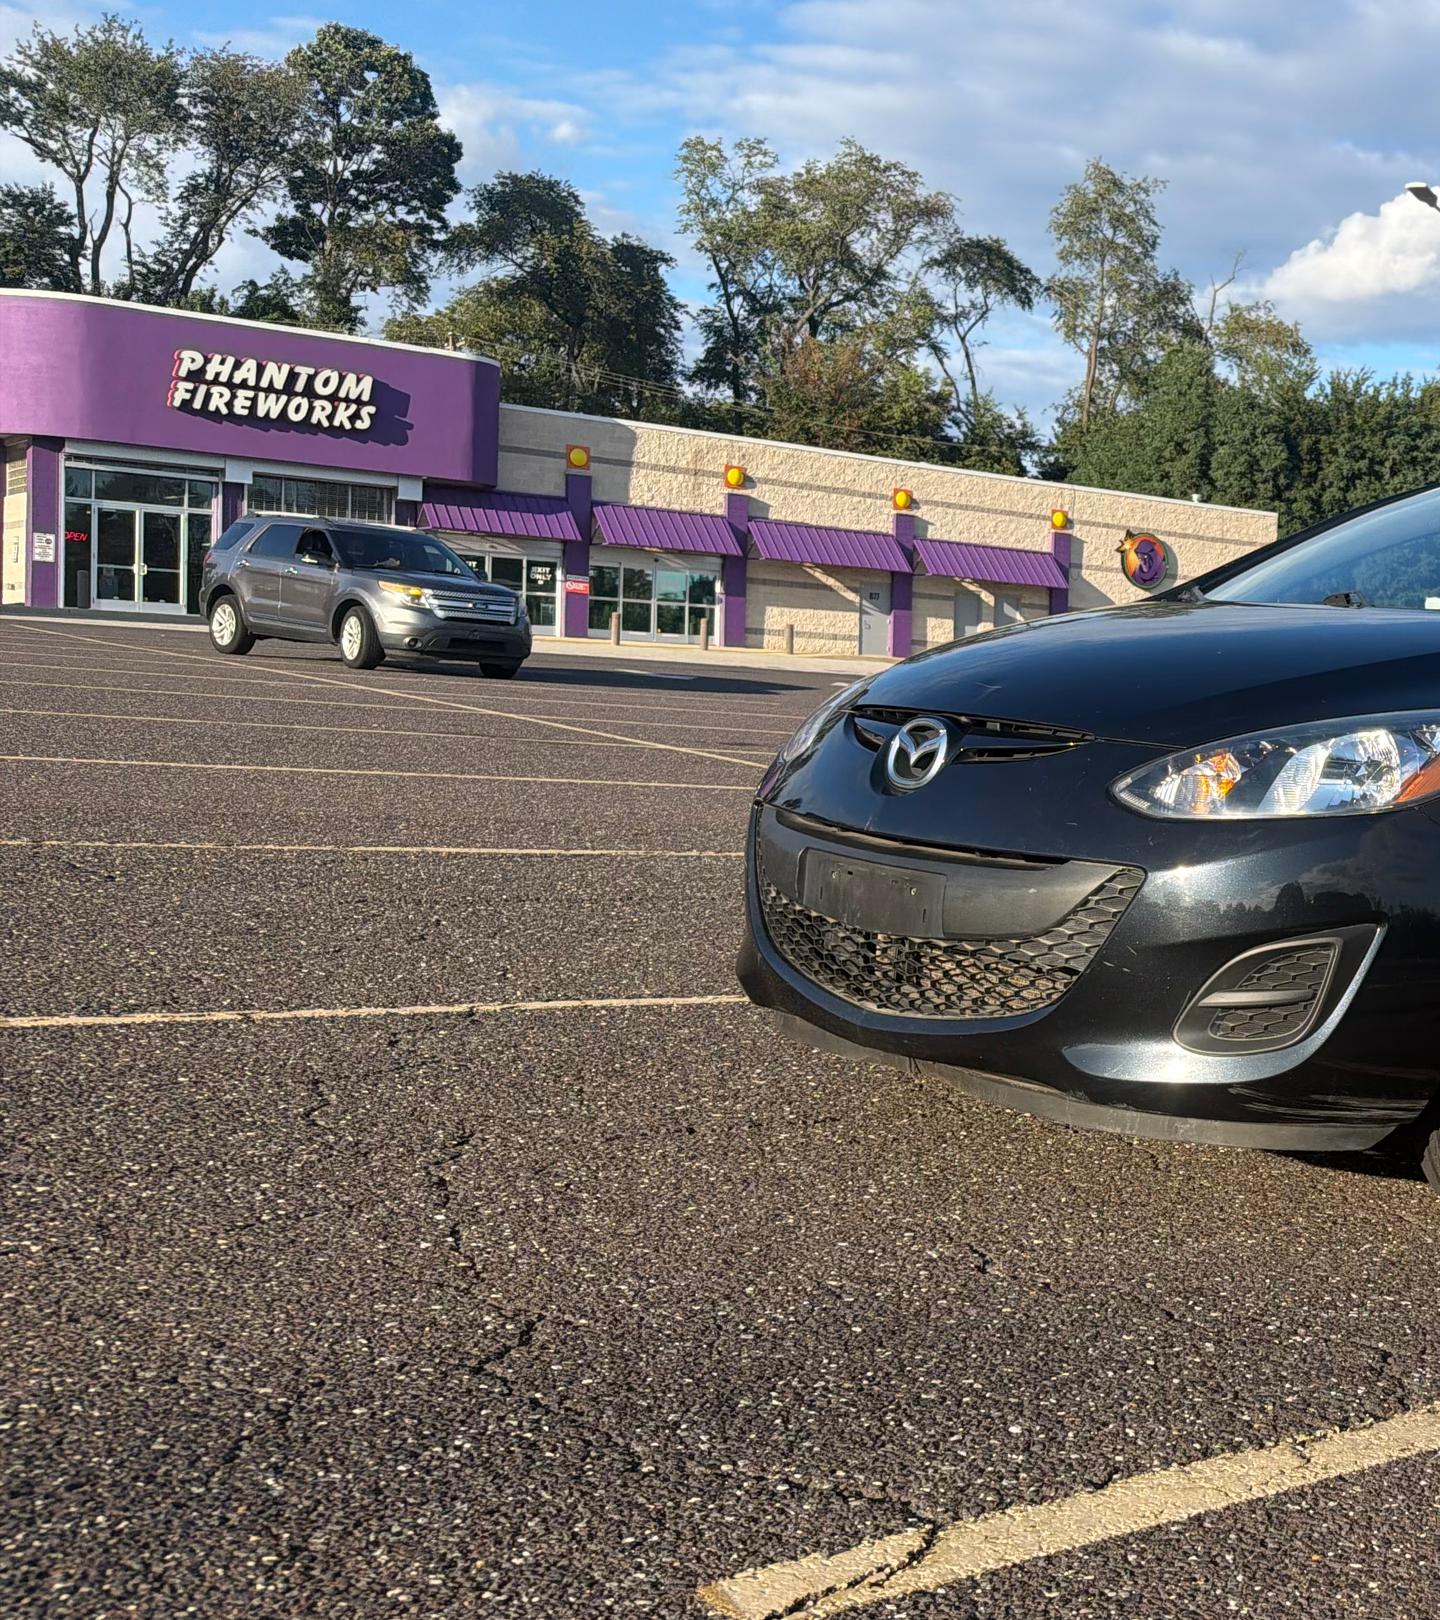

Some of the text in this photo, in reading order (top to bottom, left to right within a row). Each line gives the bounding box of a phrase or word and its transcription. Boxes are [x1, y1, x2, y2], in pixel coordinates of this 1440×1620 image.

[175, 350, 374, 402] PHANTOM
[170, 381, 377, 431] FIREWORKS
[530, 573, 552, 581] ONLY
[532, 566, 551, 574] EXIT
